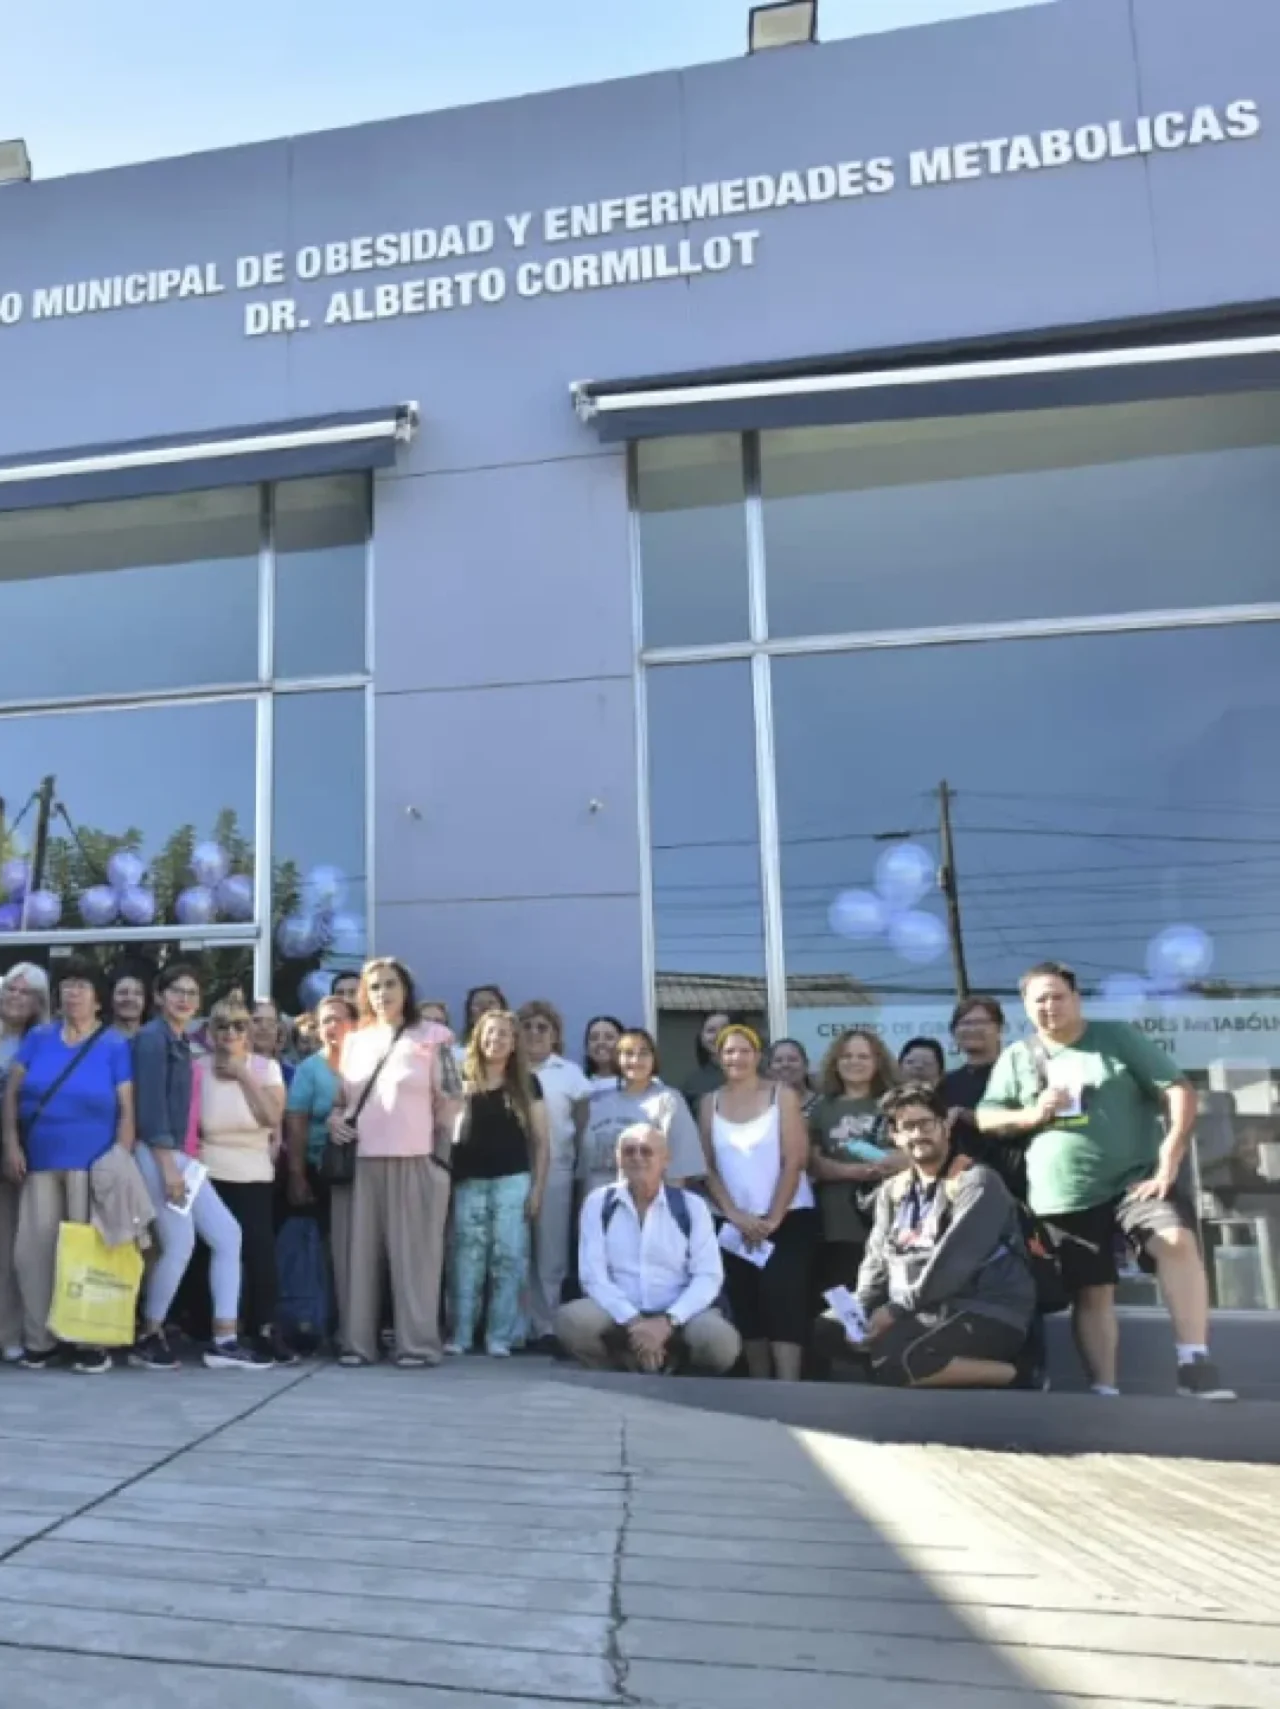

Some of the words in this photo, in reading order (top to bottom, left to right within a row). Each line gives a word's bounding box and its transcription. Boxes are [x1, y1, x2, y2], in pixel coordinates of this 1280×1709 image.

[32, 262, 225, 319] MUNICIPAL
[236, 251, 284, 288] DE
[296, 219, 495, 278] OBESIDAD
[505, 212, 532, 246] Y
[544, 156, 896, 241] ENFERMEDADES
[909, 99, 1260, 186] METABOLICAS
[245, 299, 310, 336] DR.
[324, 267, 506, 325] ALBERTO
[516, 229, 760, 297] CORMILLOT
